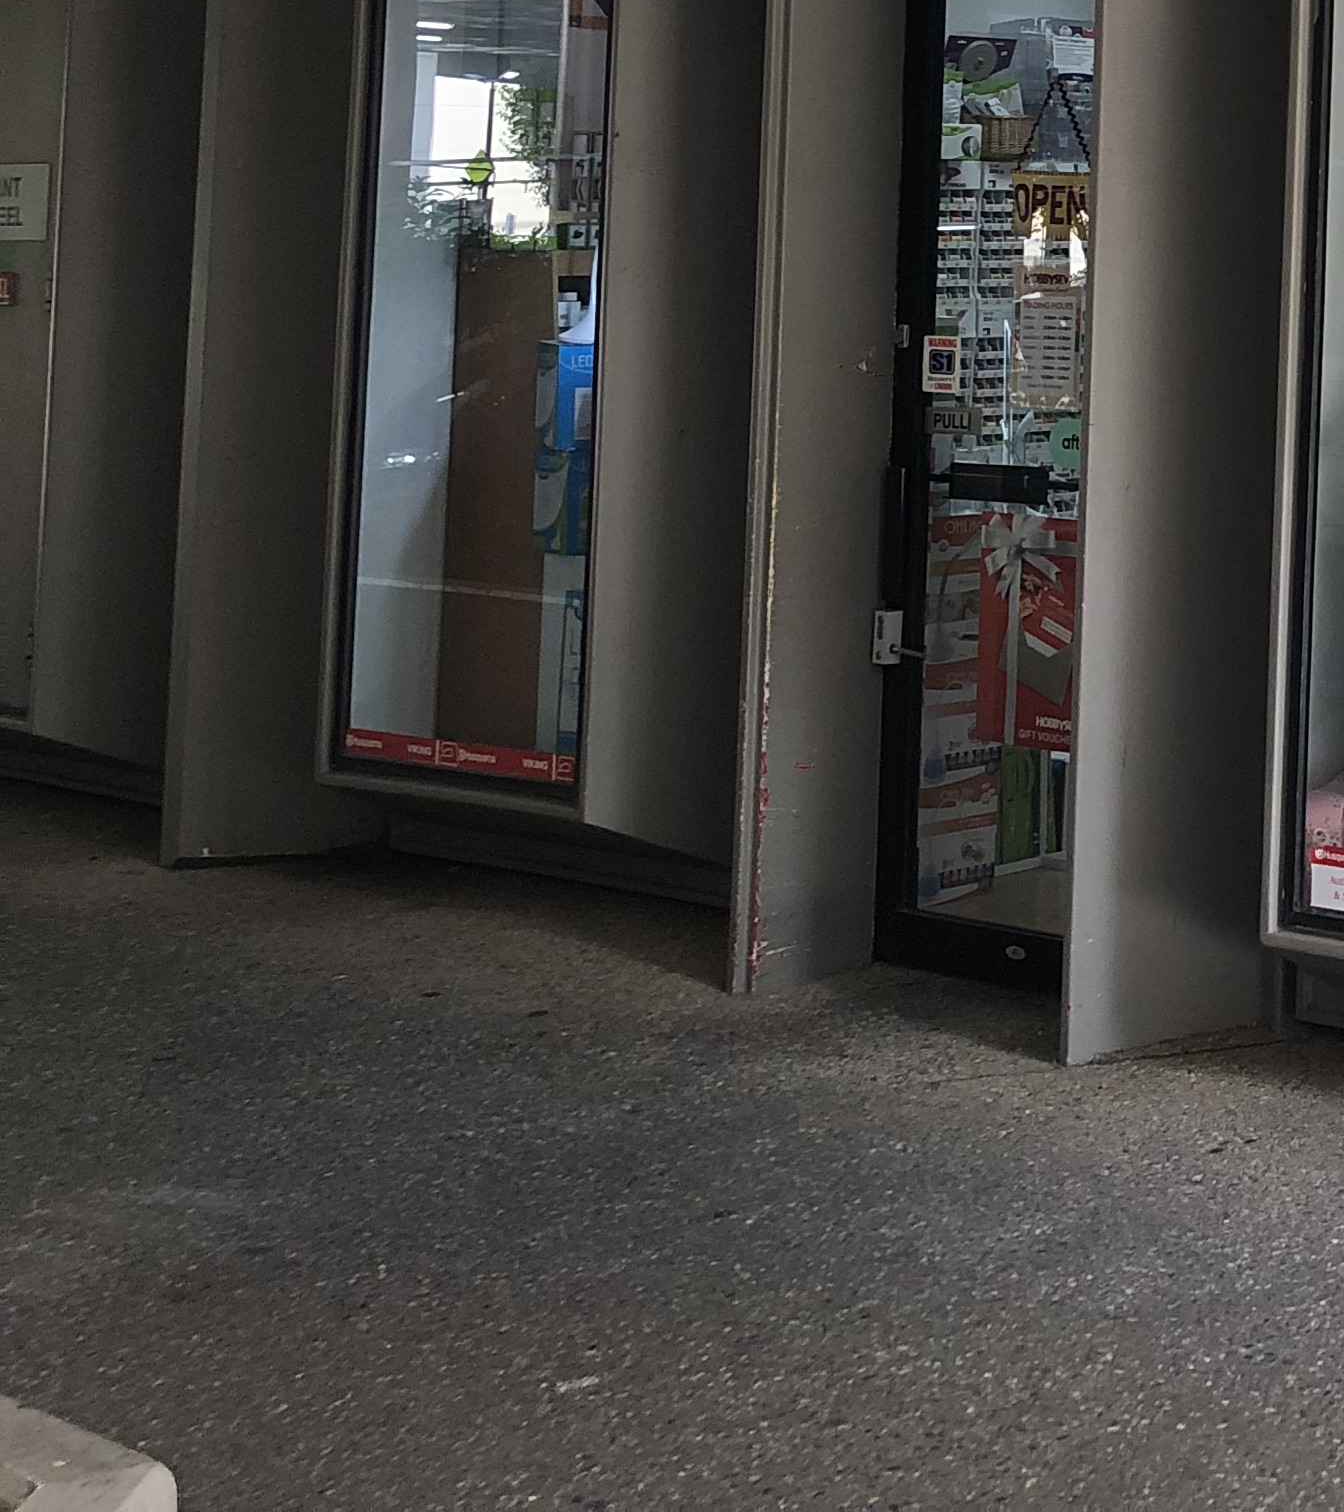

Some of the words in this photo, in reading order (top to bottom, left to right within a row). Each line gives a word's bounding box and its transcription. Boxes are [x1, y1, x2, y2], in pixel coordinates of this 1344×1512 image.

[1014, 183, 1087, 225] OPEN
[931, 353, 953, 372] S1
[933, 412, 968, 429] PULL
[1018, 729, 1037, 740] GIFT
[1333, 891, 1342, 900] &
